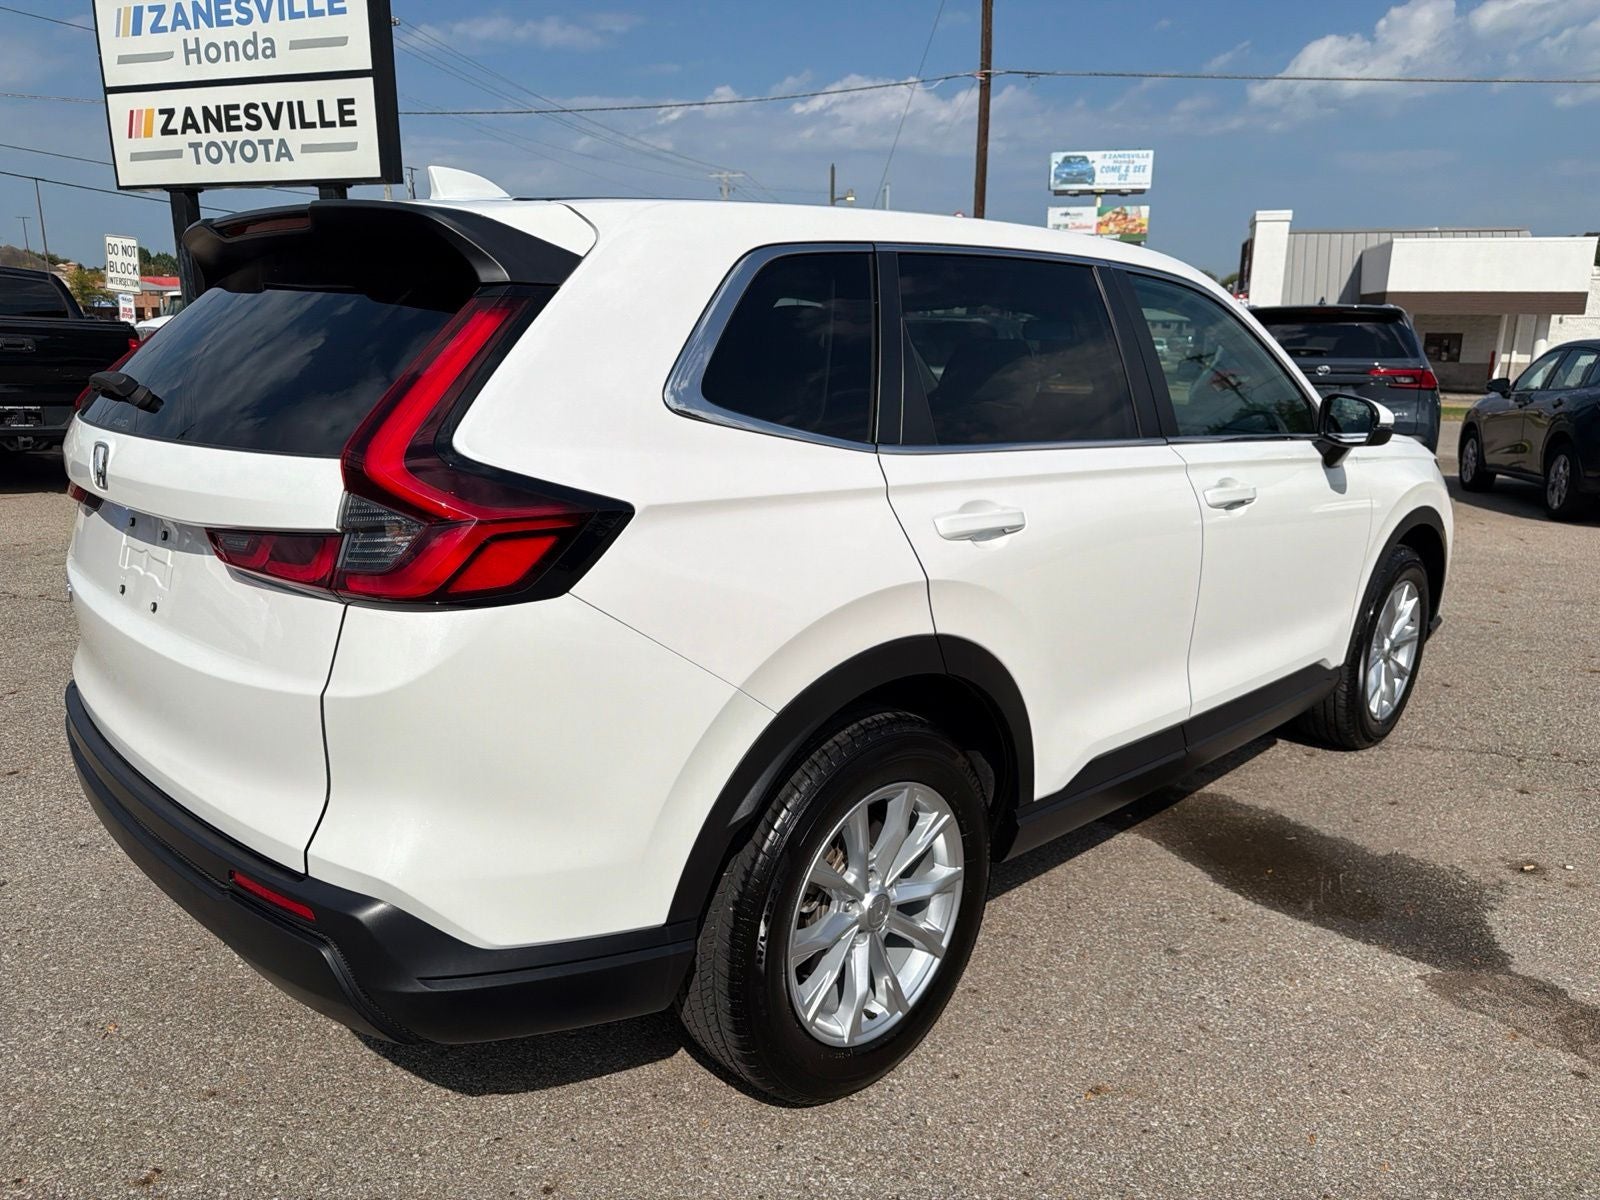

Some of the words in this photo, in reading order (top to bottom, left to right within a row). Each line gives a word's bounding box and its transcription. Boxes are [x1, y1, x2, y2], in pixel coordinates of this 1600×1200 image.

[148, 0, 347, 34] ZANESVILLE
[183, 31, 276, 65] Honda
[158, 98, 357, 137] ZANESVILLE
[188, 138, 294, 165] TOYOTA
[108, 243, 119, 256] DO
[121, 244, 136, 258] NOT
[109, 261, 138, 276] BLOCK
[109, 277, 140, 288] INTERSECTION
